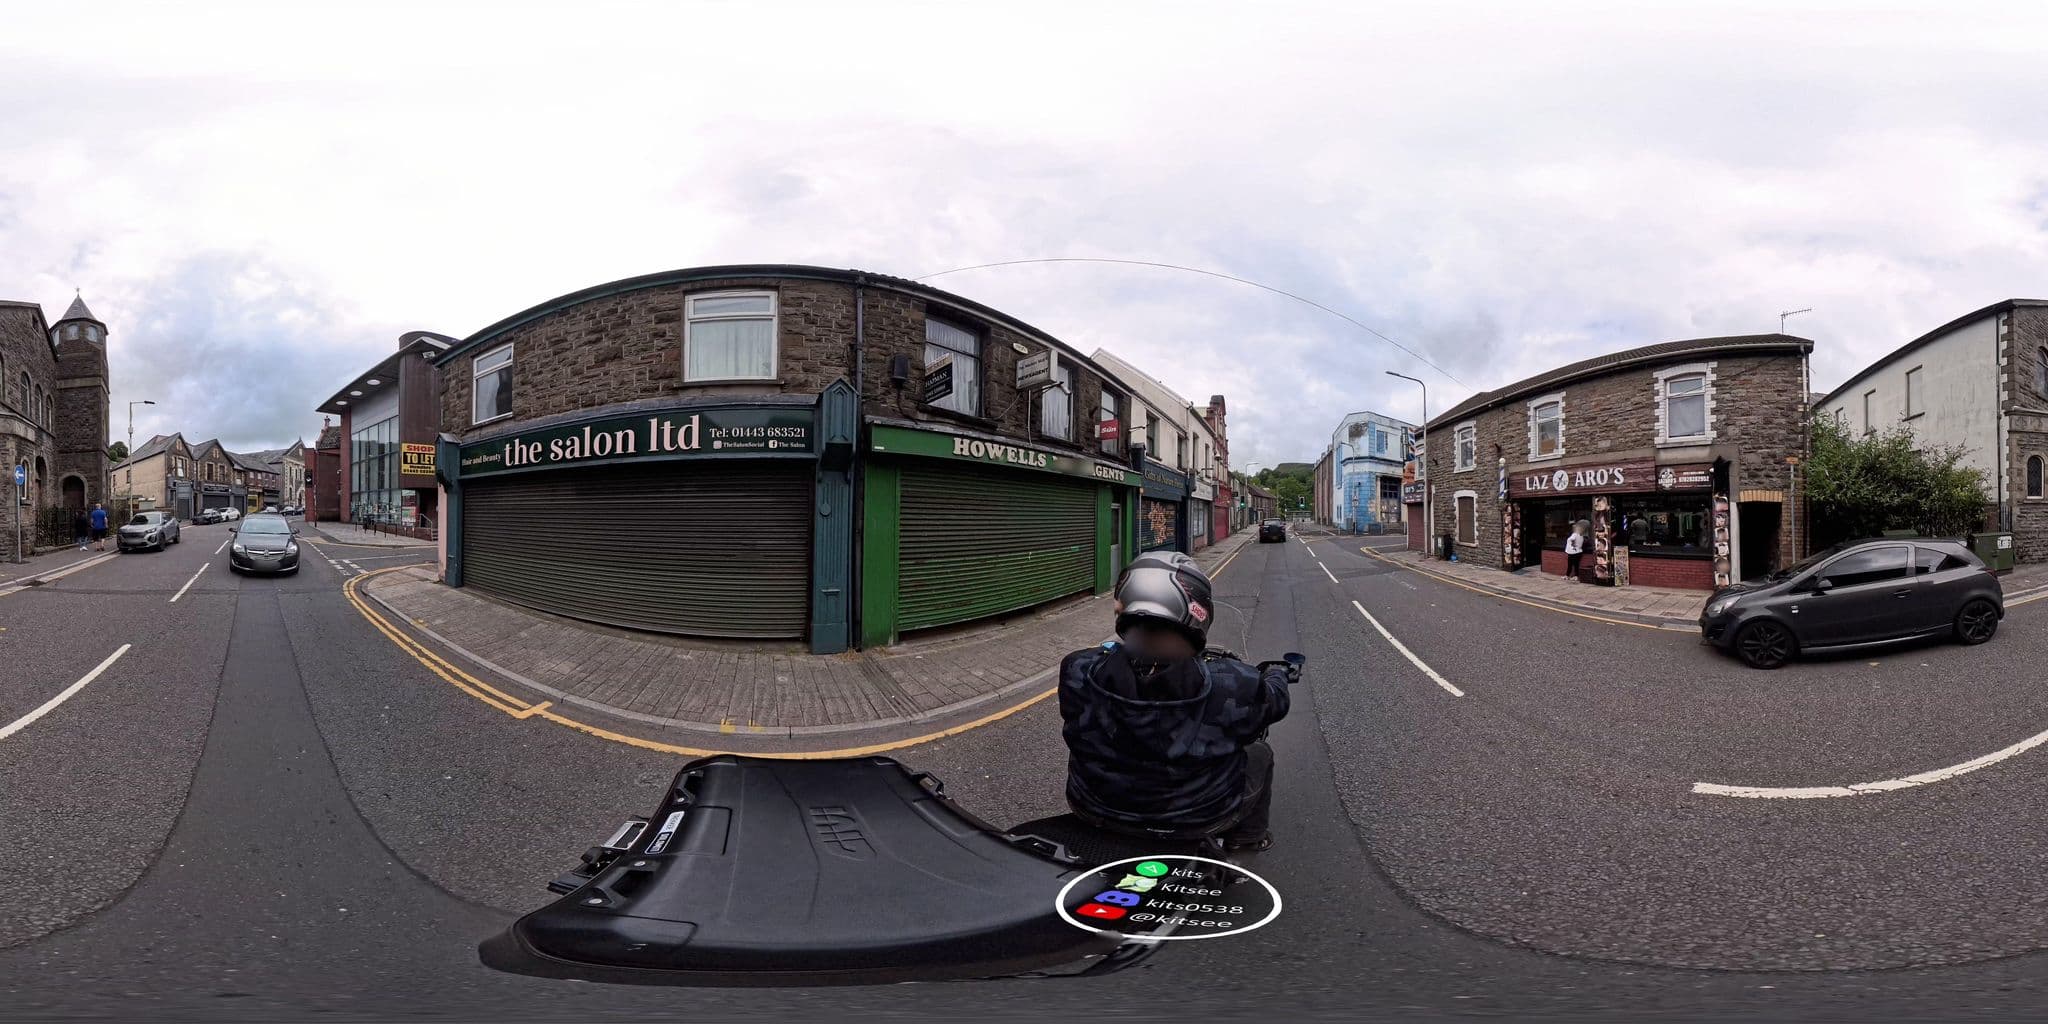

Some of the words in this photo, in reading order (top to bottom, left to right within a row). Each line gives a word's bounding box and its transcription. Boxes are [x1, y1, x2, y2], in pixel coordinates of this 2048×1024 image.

[504, 438, 542, 466] the
[550, 426, 637, 461] salon
[647, 414, 701, 452] ltd
[710, 428, 729, 438] Tel:
[732, 427, 764, 438] 01443
[767, 427, 805, 438] 683521
[406, 444, 434, 452] SHOP
[953, 437, 1047, 468] HOWELLS
[405, 453, 418, 464] TO
[420, 453, 434, 465] LET
[1525, 474, 1549, 491] LAZ
[1575, 467, 1625, 487] ARO'S
